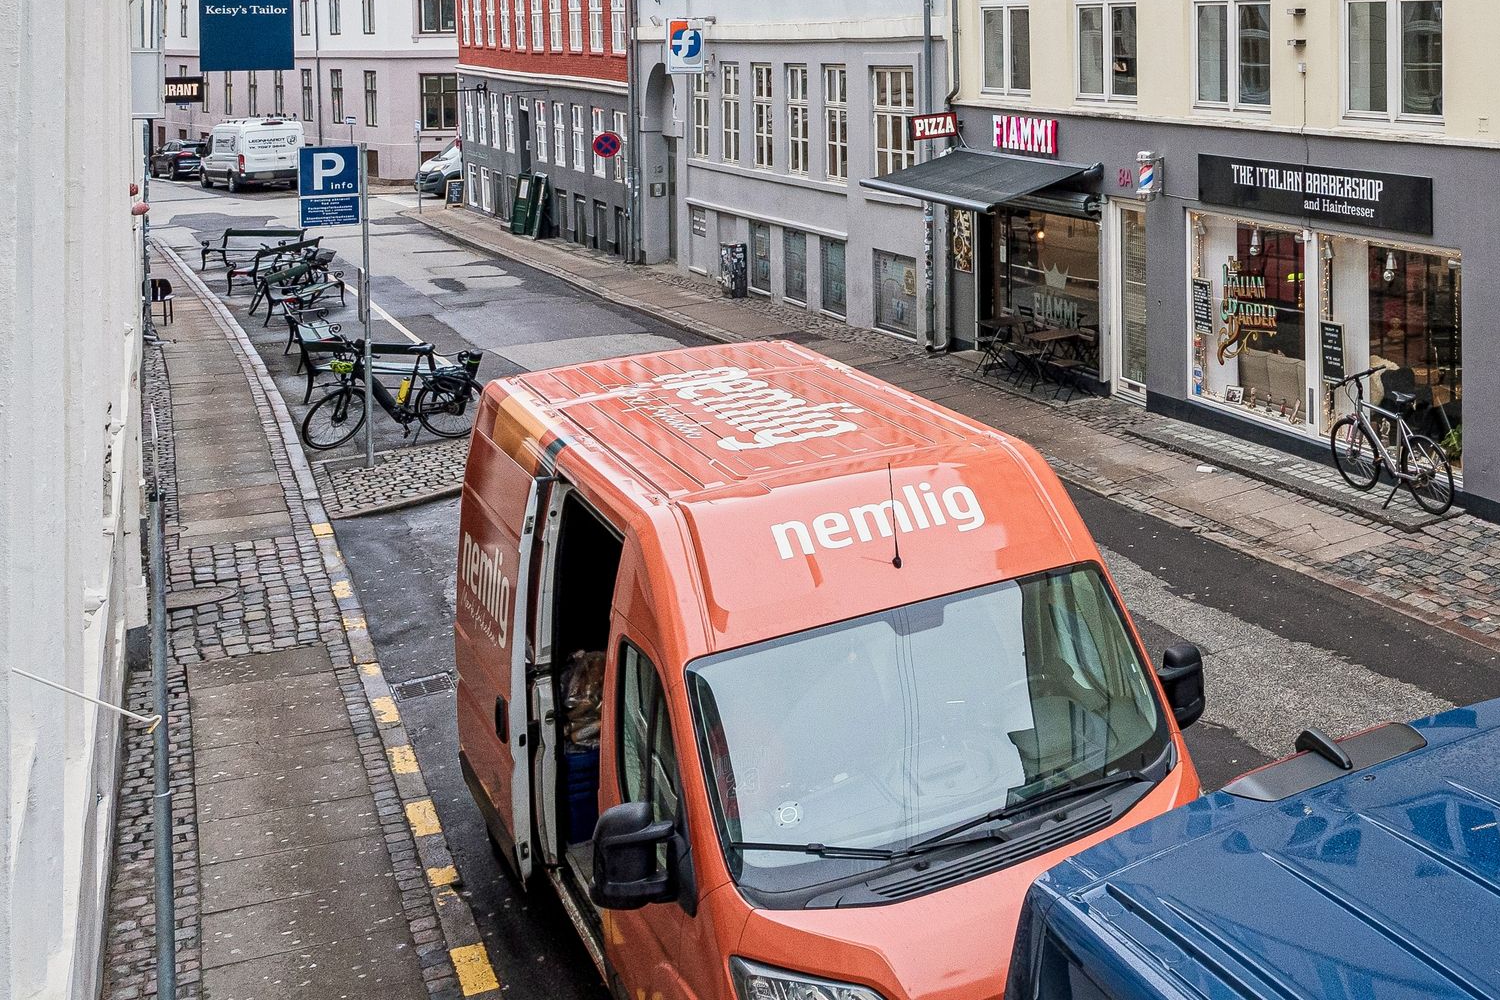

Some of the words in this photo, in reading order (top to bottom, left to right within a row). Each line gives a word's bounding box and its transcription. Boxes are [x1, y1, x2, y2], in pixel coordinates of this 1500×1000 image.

[205, 5, 247, 16] Keisy's
[250, 5, 287, 15] Tailor
[914, 116, 955, 137] PIZZA
[992, 114, 1058, 154] FIAMMI
[313, 153, 345, 190] P
[331, 181, 353, 190] info
[1118, 167, 1133, 188] 8A
[1231, 164, 1254, 186] THE
[1256, 166, 1303, 193] ITALIAN
[1305, 172, 1384, 202] BARBERSHOP
[1304, 198, 1320, 211] and
[1322, 200, 1375, 218] Hairdresser
[1034, 292, 1078, 329] FIAMMI
[771, 481, 985, 560] nemlig
[462, 531, 509, 649] nemlig
